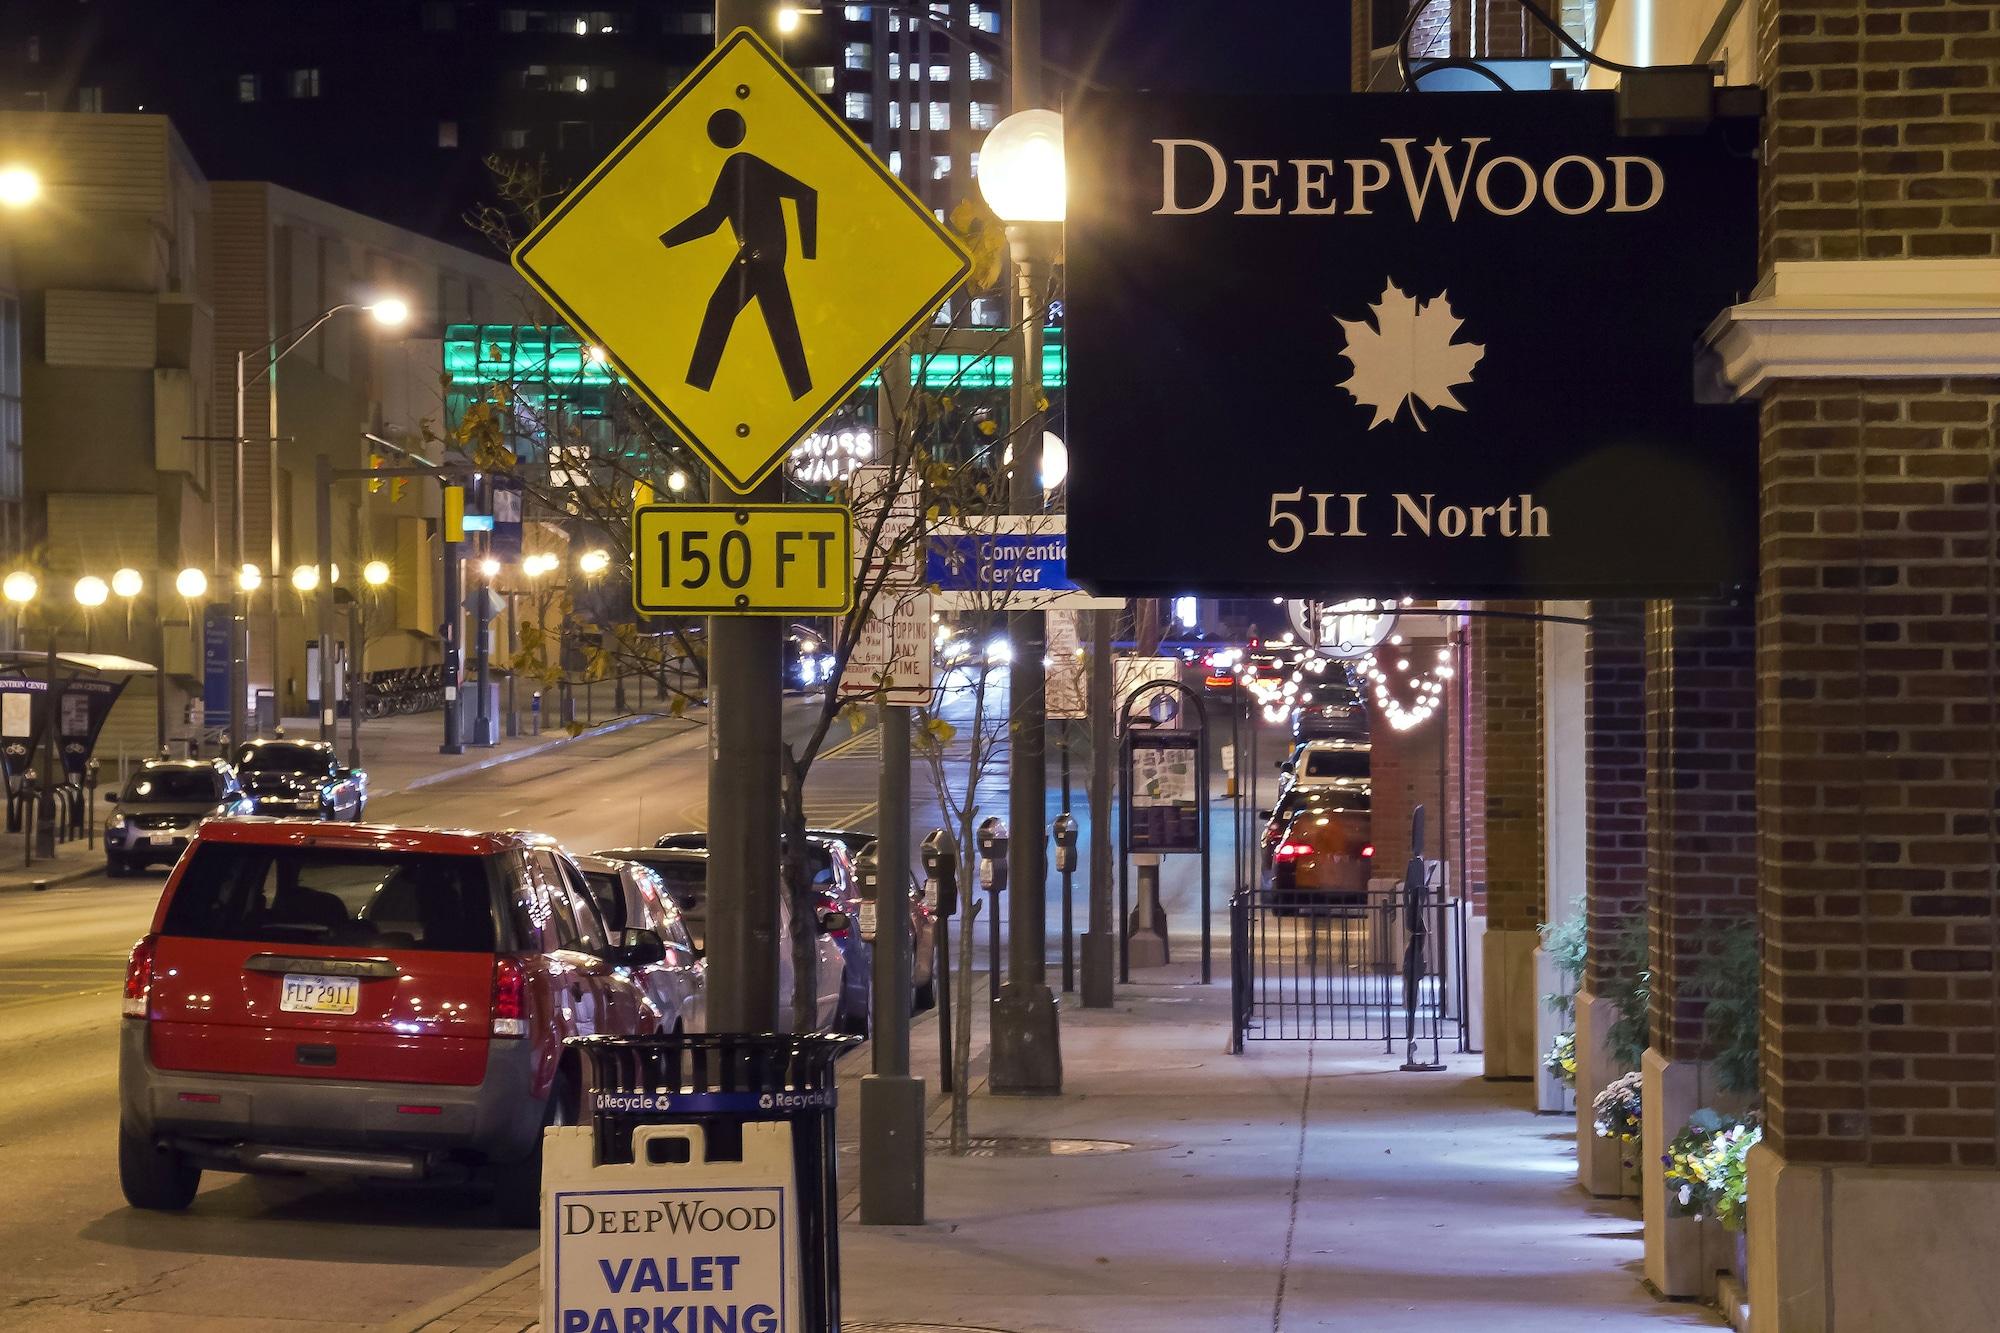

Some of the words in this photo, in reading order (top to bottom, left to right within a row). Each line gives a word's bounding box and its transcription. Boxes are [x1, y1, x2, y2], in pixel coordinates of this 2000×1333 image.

[1392, 490, 1551, 538] North
[658, 530, 752, 590] 150
[777, 531, 835, 589] FT
[980, 564, 1042, 583] Center
[895, 600, 914, 617] NO
[895, 644, 919, 657] ANY
[893, 661, 920, 675] TIME
[287, 983, 314, 1003] FLP
[318, 986, 352, 1005] 2911
[604, 1094, 653, 1112] Recycle
[776, 1092, 824, 1108] Recycle
[598, 1255, 740, 1294] VALET
[564, 1303, 778, 1333] PARKING
